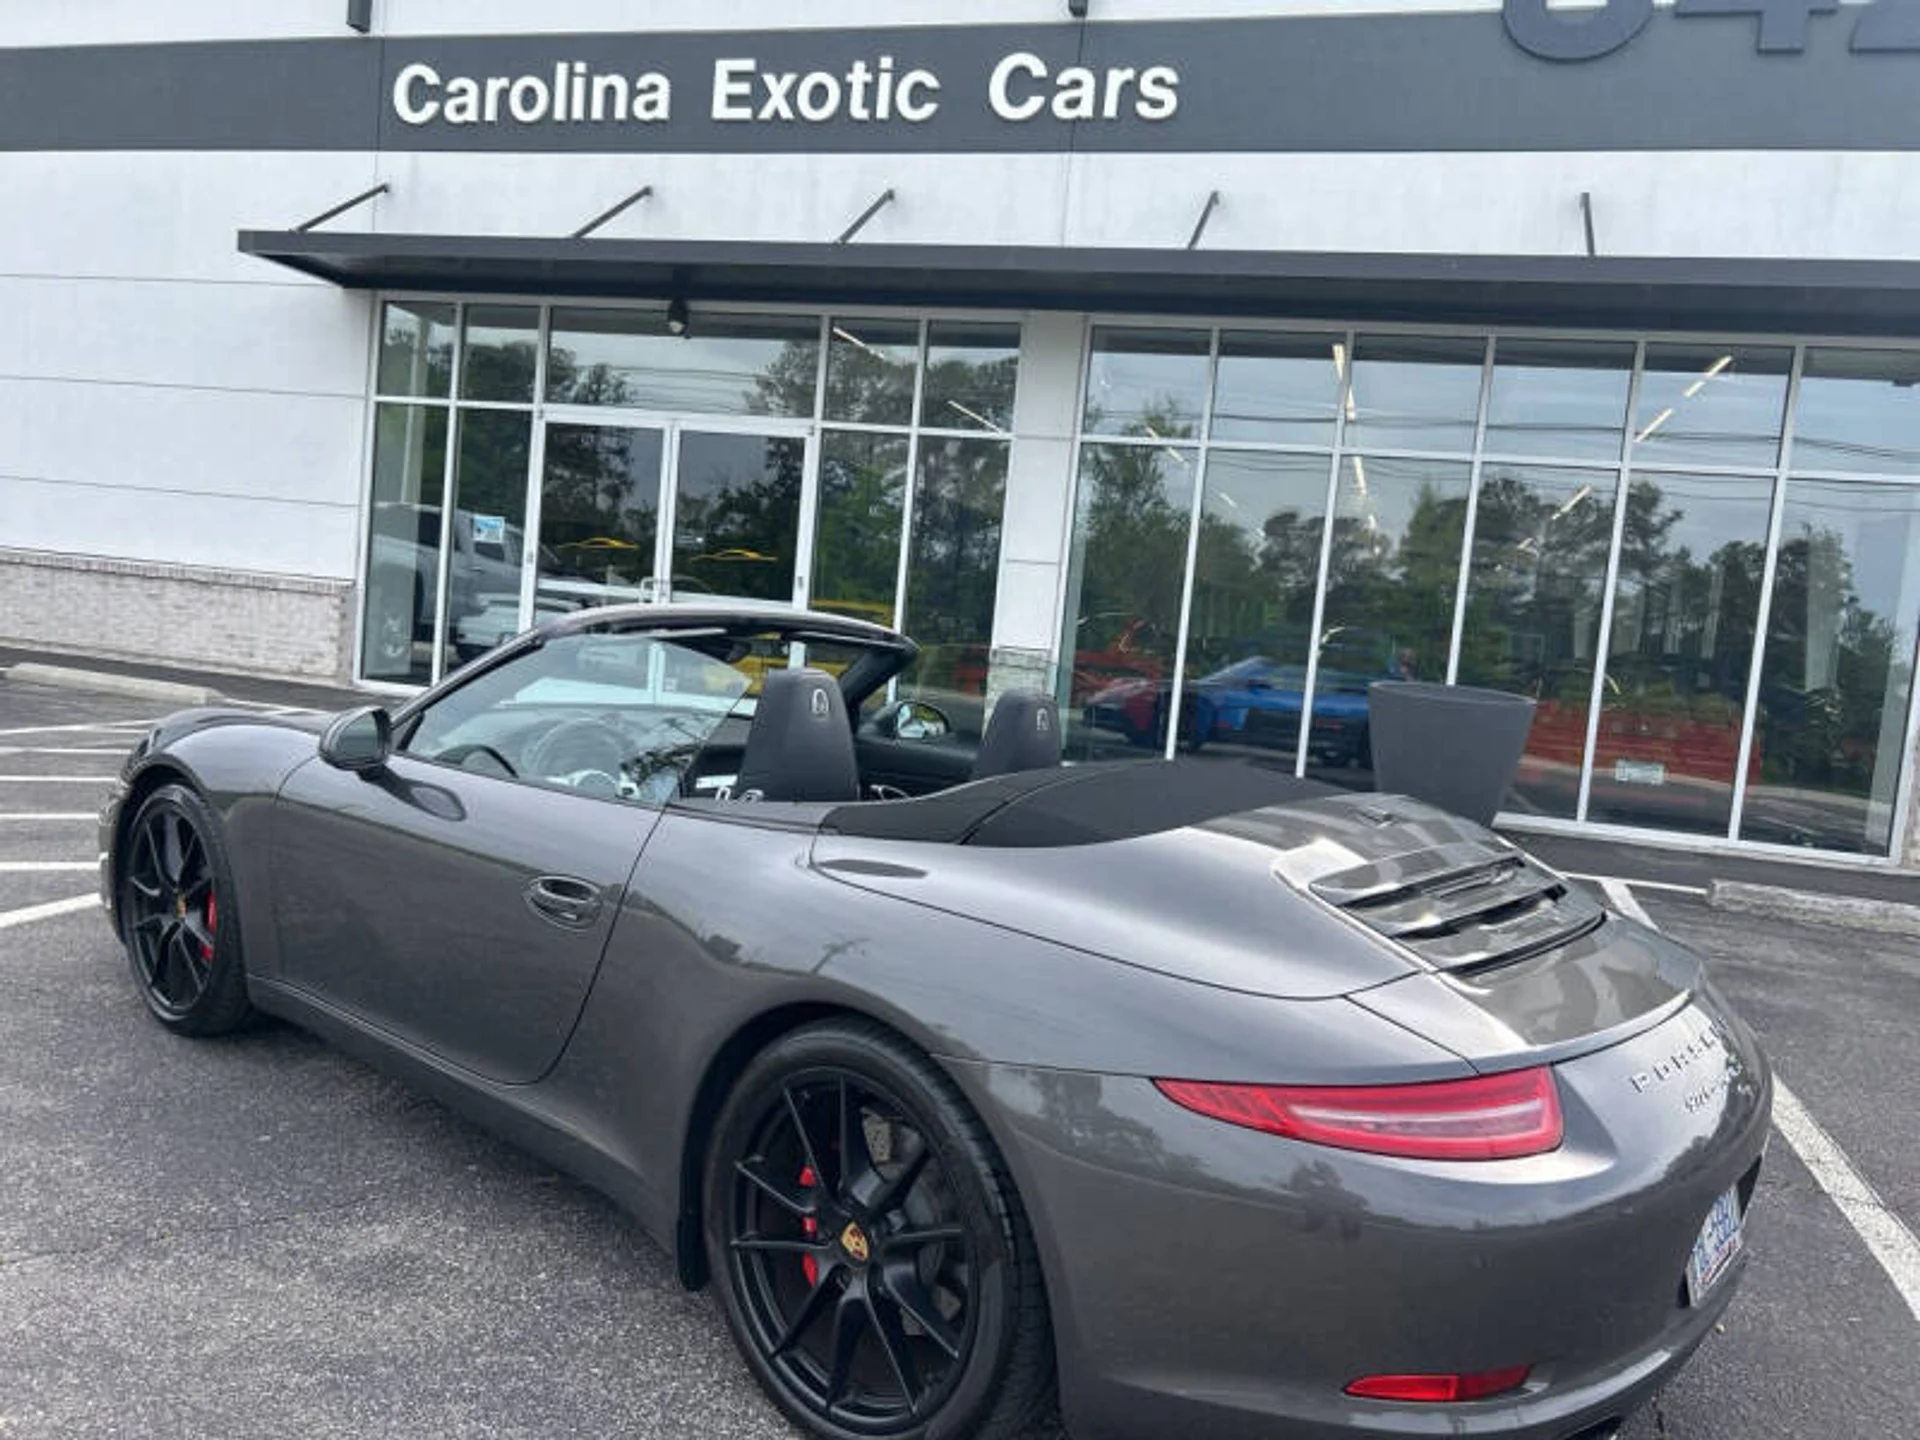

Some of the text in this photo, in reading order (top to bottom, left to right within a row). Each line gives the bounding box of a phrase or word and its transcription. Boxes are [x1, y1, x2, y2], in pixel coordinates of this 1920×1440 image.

[393, 52, 1179, 124] Carolina Exotic Cars
